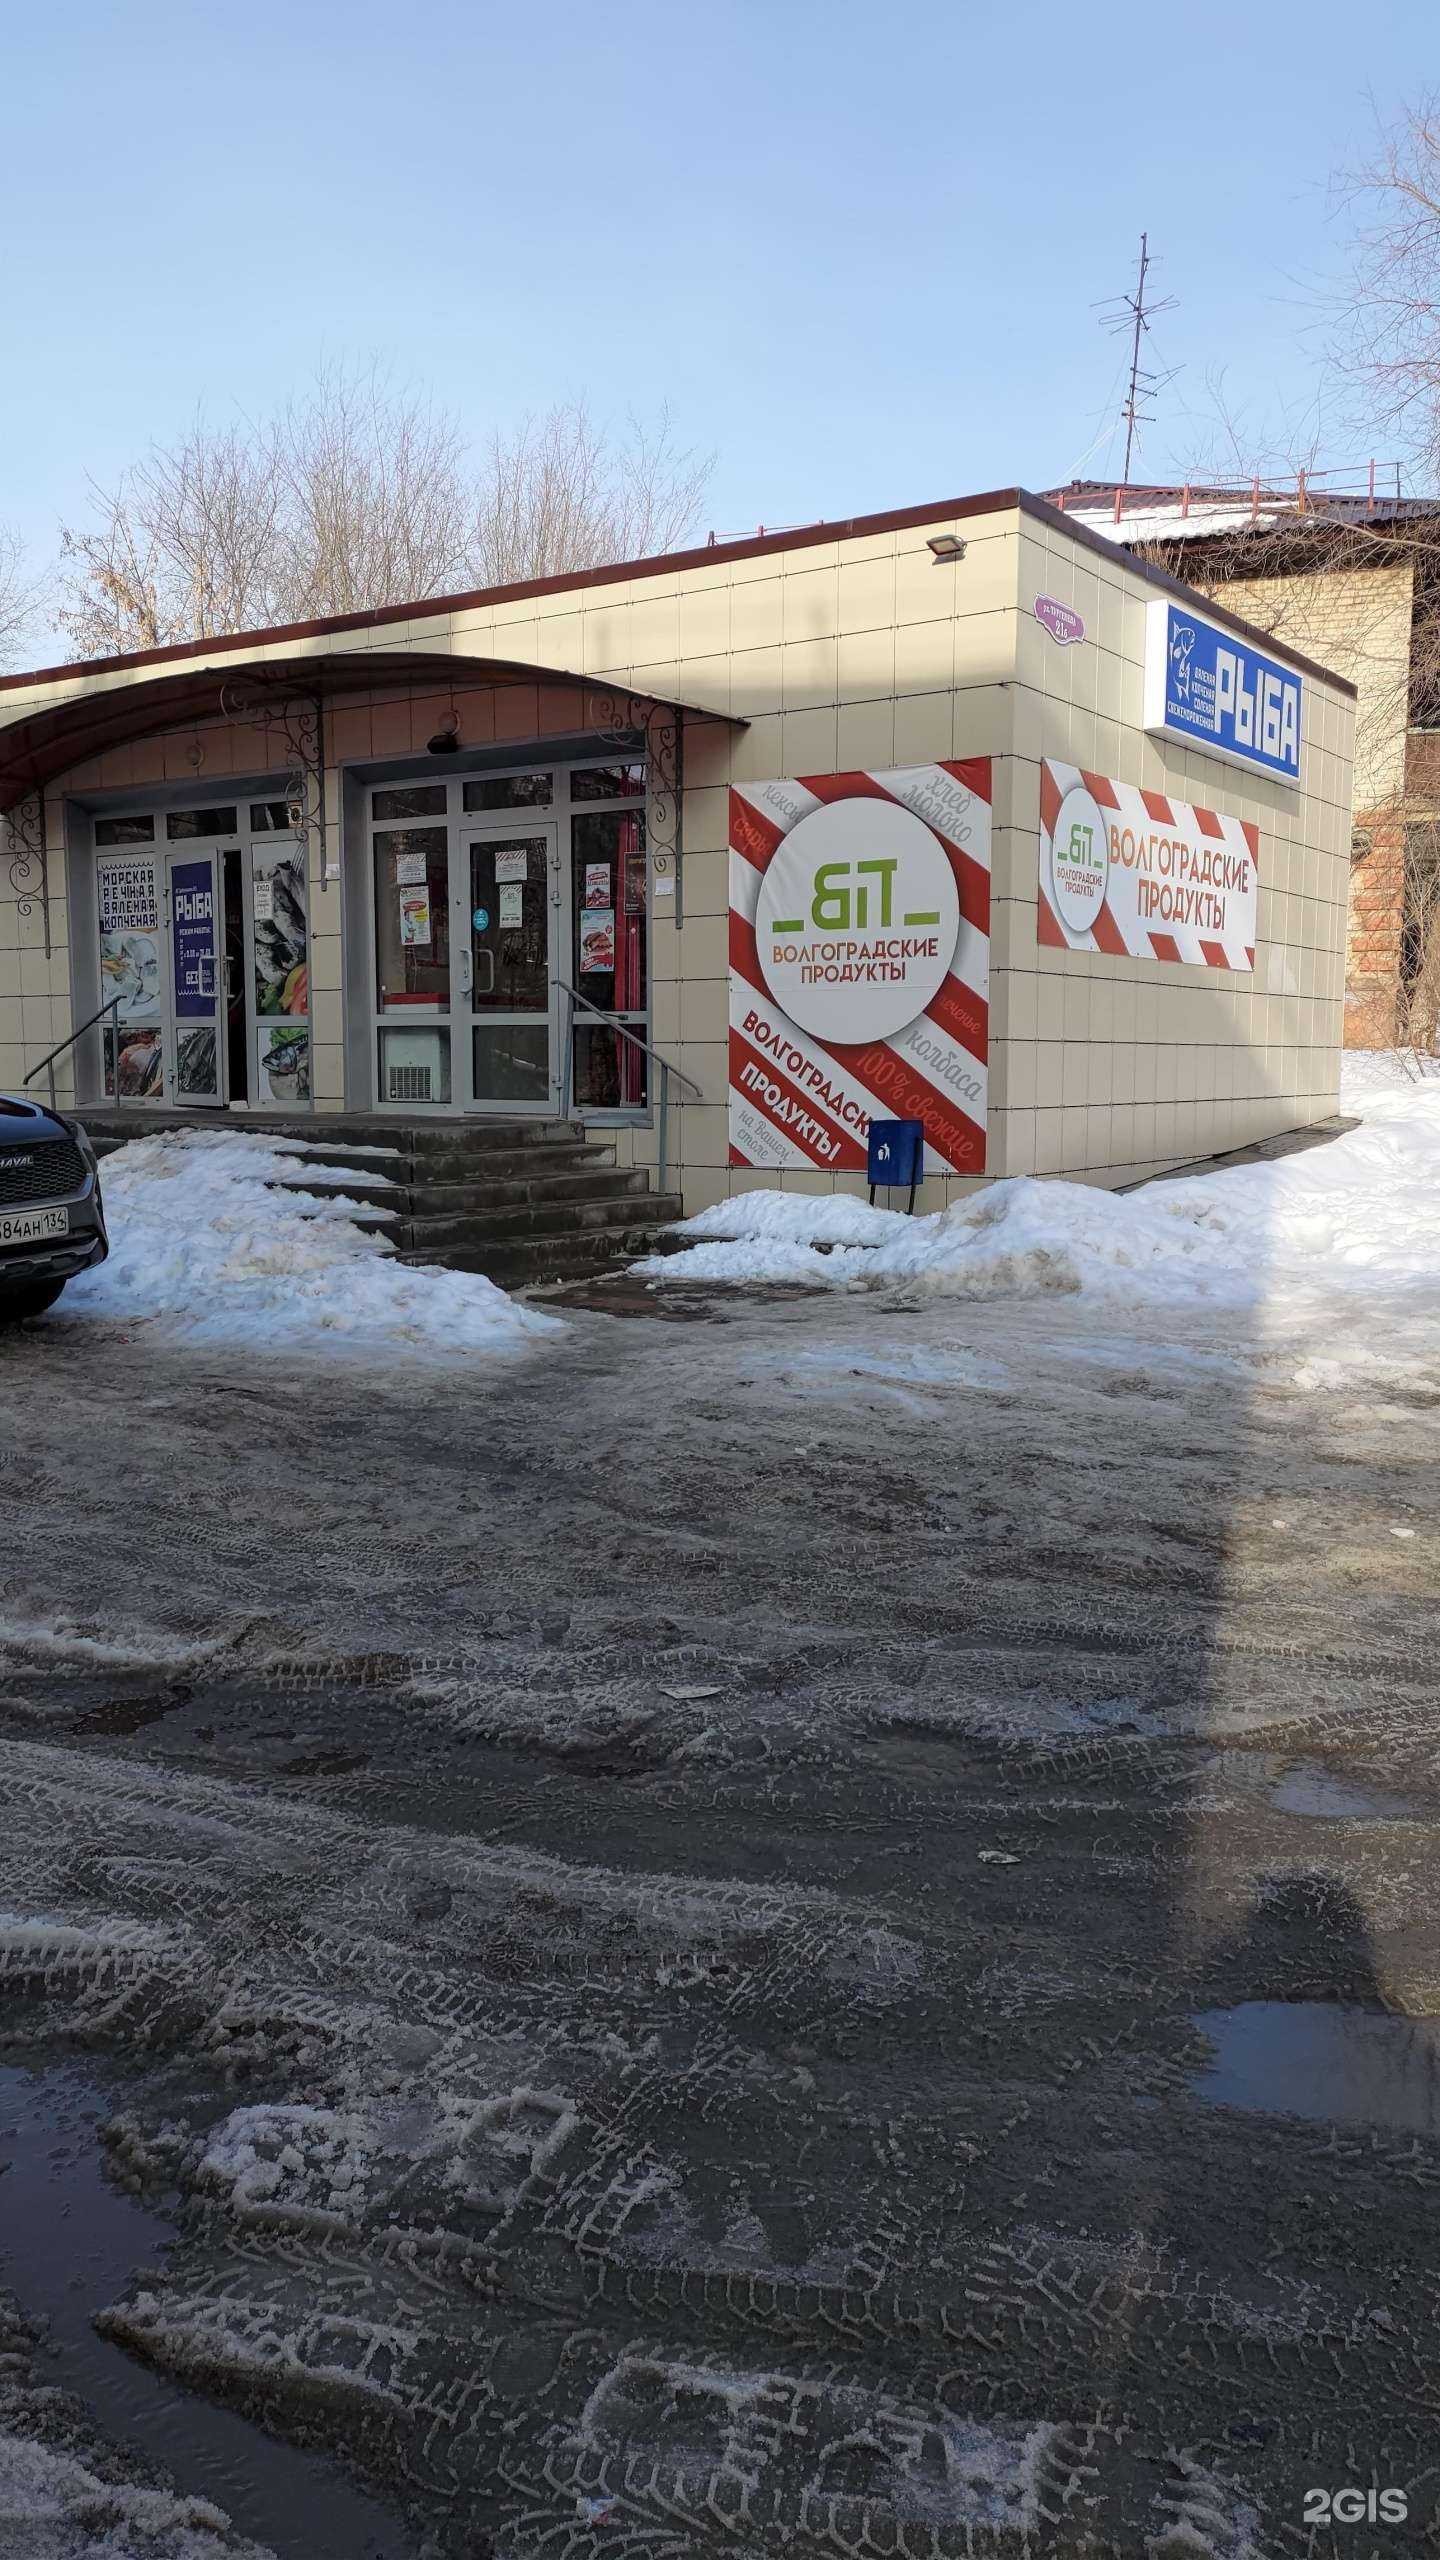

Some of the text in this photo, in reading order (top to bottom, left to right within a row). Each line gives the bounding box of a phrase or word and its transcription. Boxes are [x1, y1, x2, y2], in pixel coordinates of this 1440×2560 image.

[1215, 646, 1298, 767] РЫБА
[925, 776, 973, 814] хлеб
[902, 785, 973, 842] молоко
[1110, 824, 1249, 893] ВОЛГОГРАДСКИЕ
[103, 869, 154, 885] МОРСКАЯ
[1057, 866, 1103, 887] ВОЛГОГРАДСКИЕ
[1065, 881, 1095, 897] ПРОДУКТЫ
[105, 899, 155, 914] ВЯЛЕНАЯ
[175, 892, 212, 921] РЫБА
[1138, 878, 1225, 930] ПРОДУКТЫ
[105, 914, 156, 928] КОПЧЕНАЯ
[773, 938, 938, 963] ВОЛГОГРАДСКИЕ
[801, 962, 906, 984] ПРОДУКТЫ
[742, 1009, 873, 1138] ВОЛГОГРАДСК
[905, 1030, 983, 1102] колбаса
[738, 1110, 755, 1128] на
[739, 1061, 842, 1162] ПРОДУКТЫ
[906, 1094, 974, 1158] свежие
[737, 1128, 769, 1160] столе
[43, 1212, 65, 1227] 134
